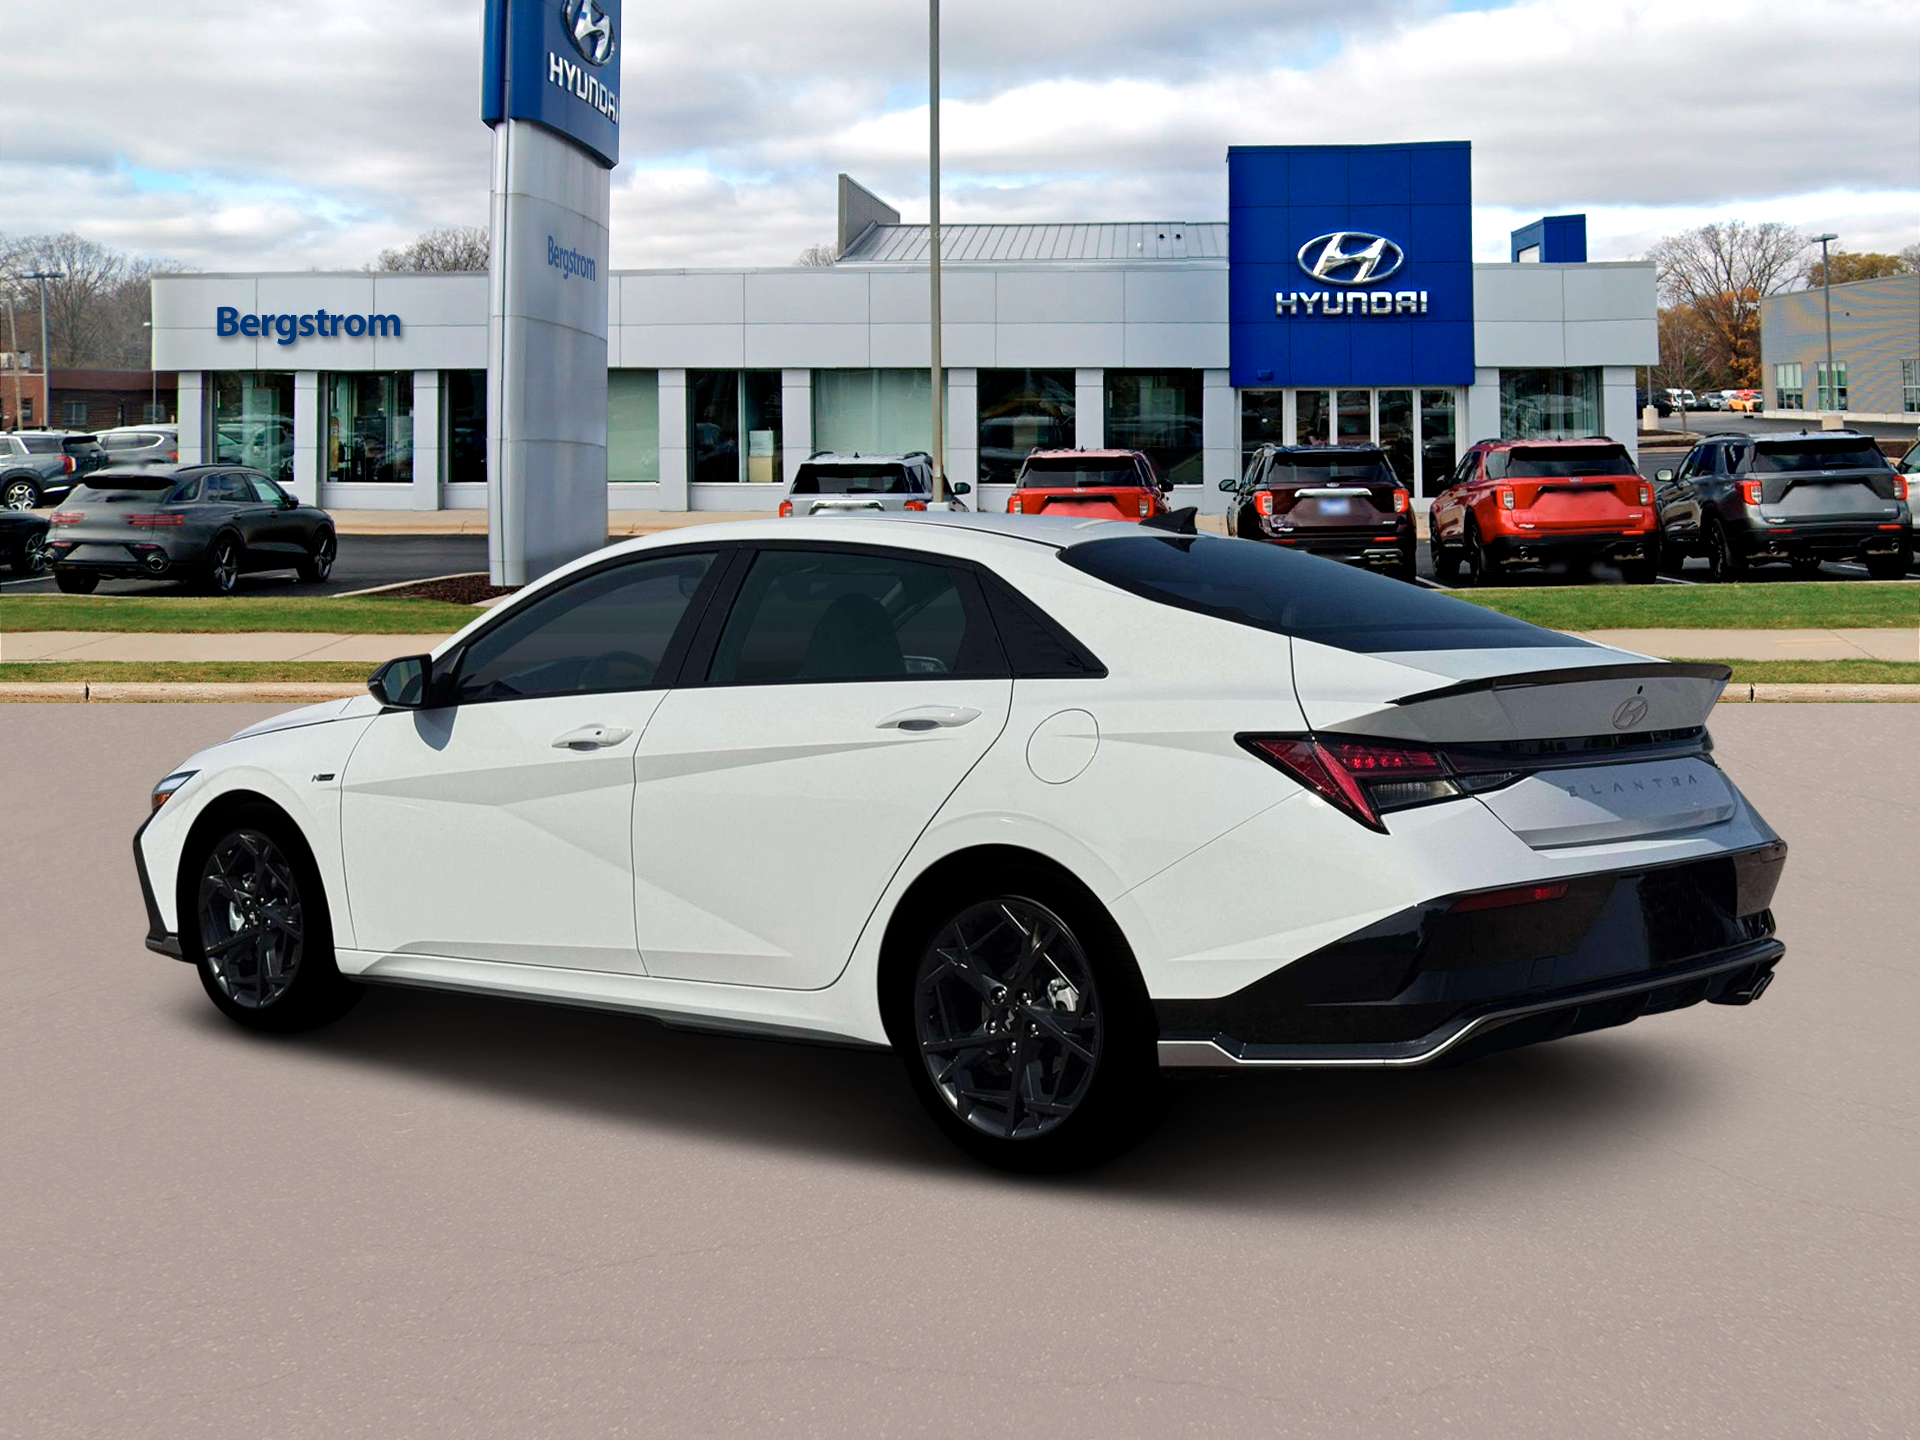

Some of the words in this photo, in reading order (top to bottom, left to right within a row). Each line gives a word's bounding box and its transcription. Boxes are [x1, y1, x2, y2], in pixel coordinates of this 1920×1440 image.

[549, 51, 619, 124] HYUNDAI
[547, 235, 596, 282] Bergstrom
[1275, 291, 1428, 315] HYUNDAI
[216, 306, 402, 346] Bergstrom
[1567, 774, 1697, 797] ELANTRA
